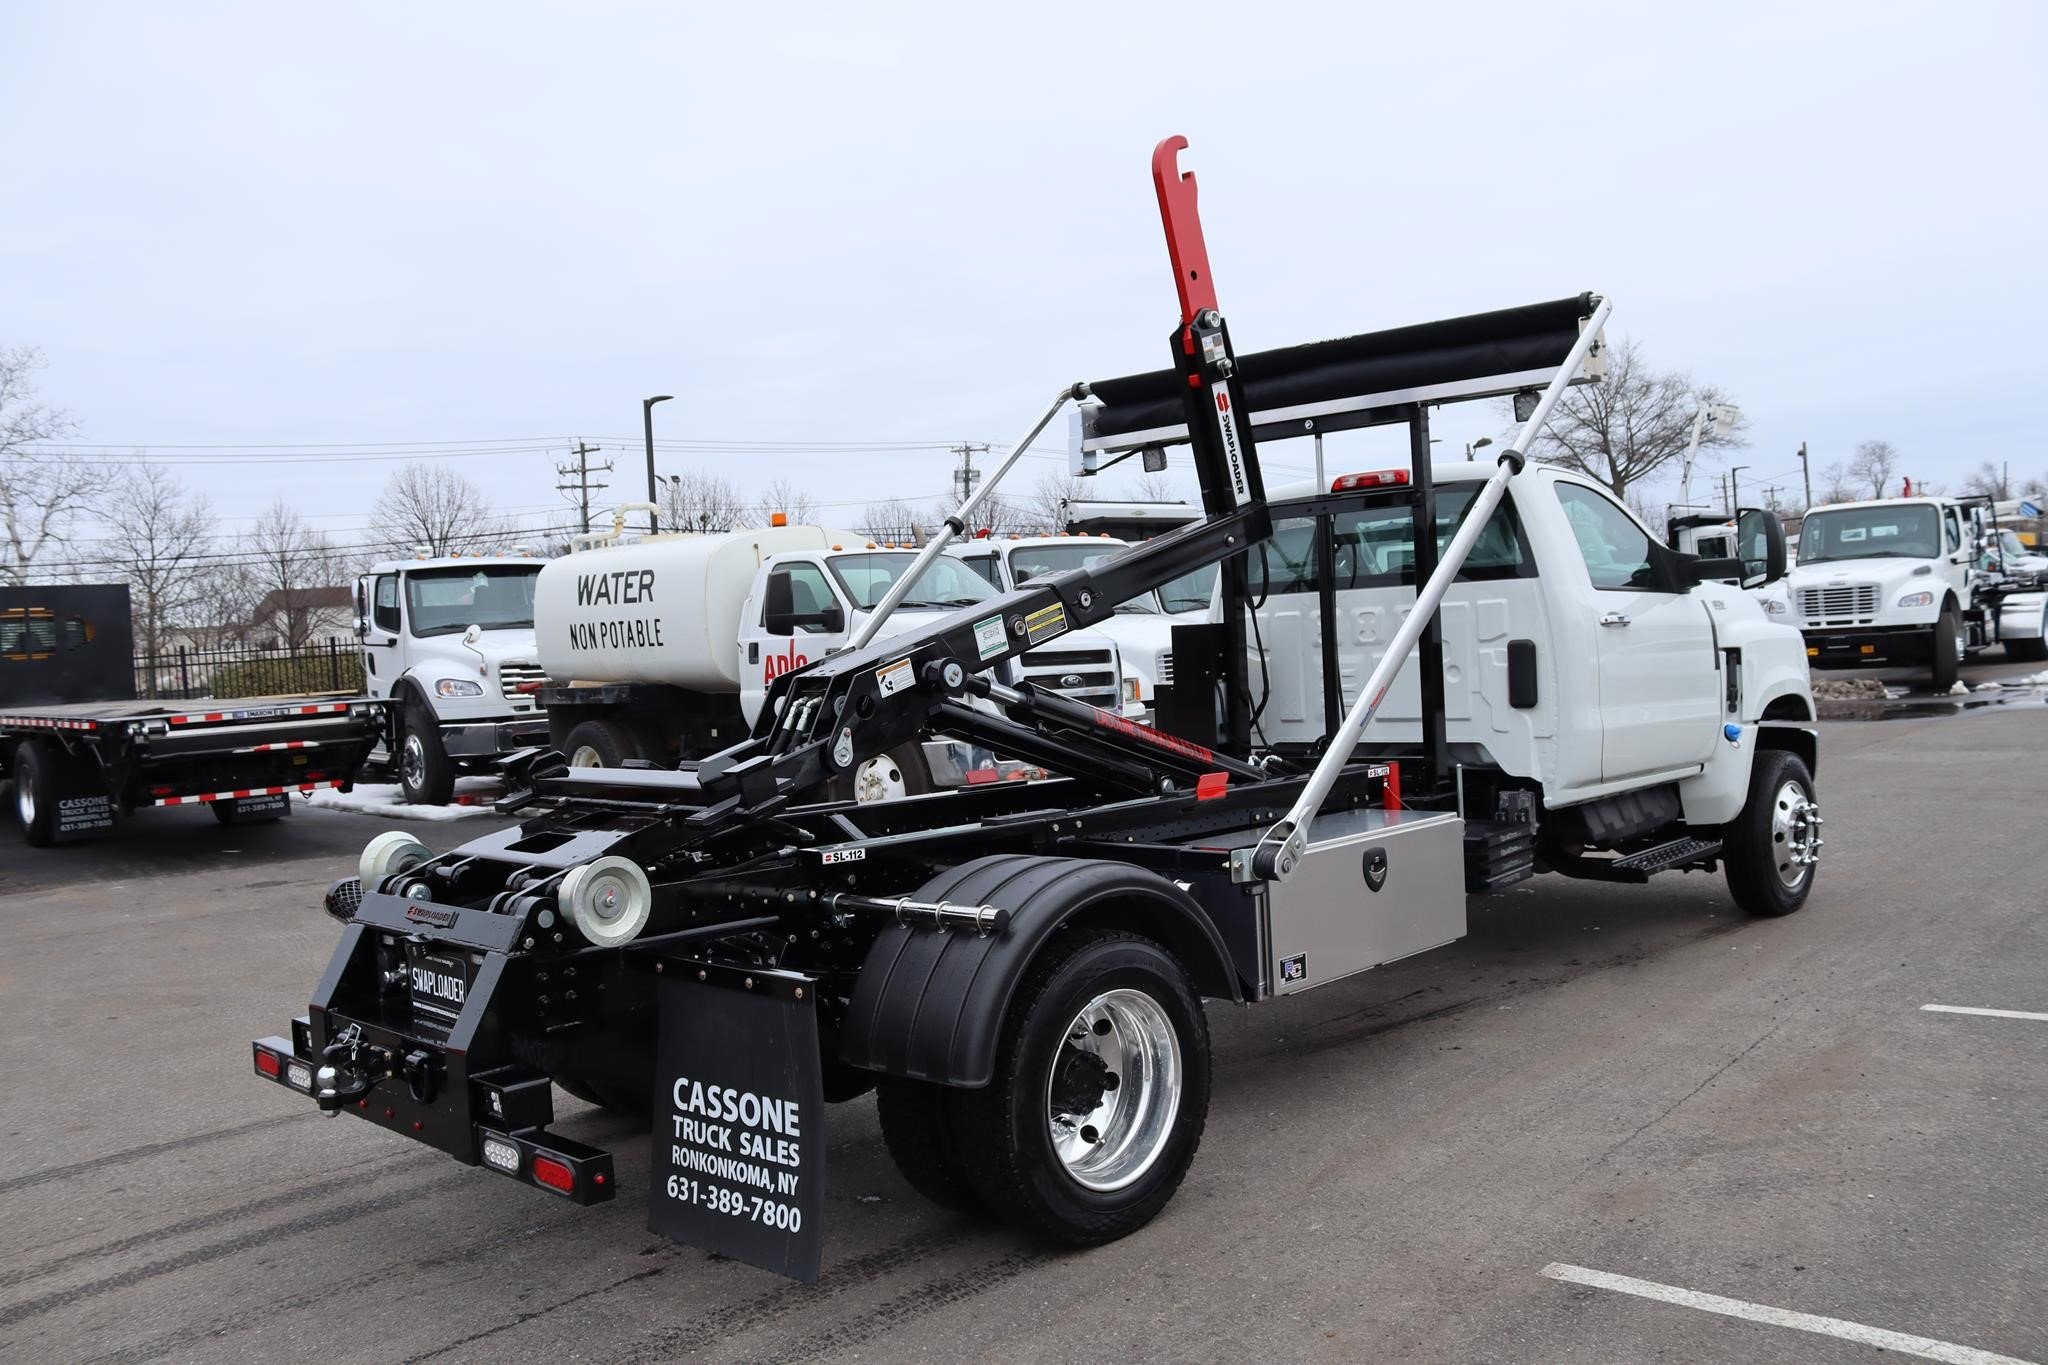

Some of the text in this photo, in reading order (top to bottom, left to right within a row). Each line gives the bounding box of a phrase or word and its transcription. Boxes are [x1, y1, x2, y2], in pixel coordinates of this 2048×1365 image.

[1222, 414, 1245, 495] SWAPLOADER
[577, 569, 655, 606] WATER
[569, 618, 664, 650] NON POTABLE
[59, 796, 109, 809] CASSONE
[833, 850, 862, 862] SL-112
[412, 967, 465, 1004] SWAPLOADER
[673, 1077, 800, 1137] CASSONE
[672, 1114, 800, 1168] TRUCK SALES
[672, 1145, 799, 1197] RONKONKOMA, NY
[667, 1174, 801, 1234] 631-389-7800
